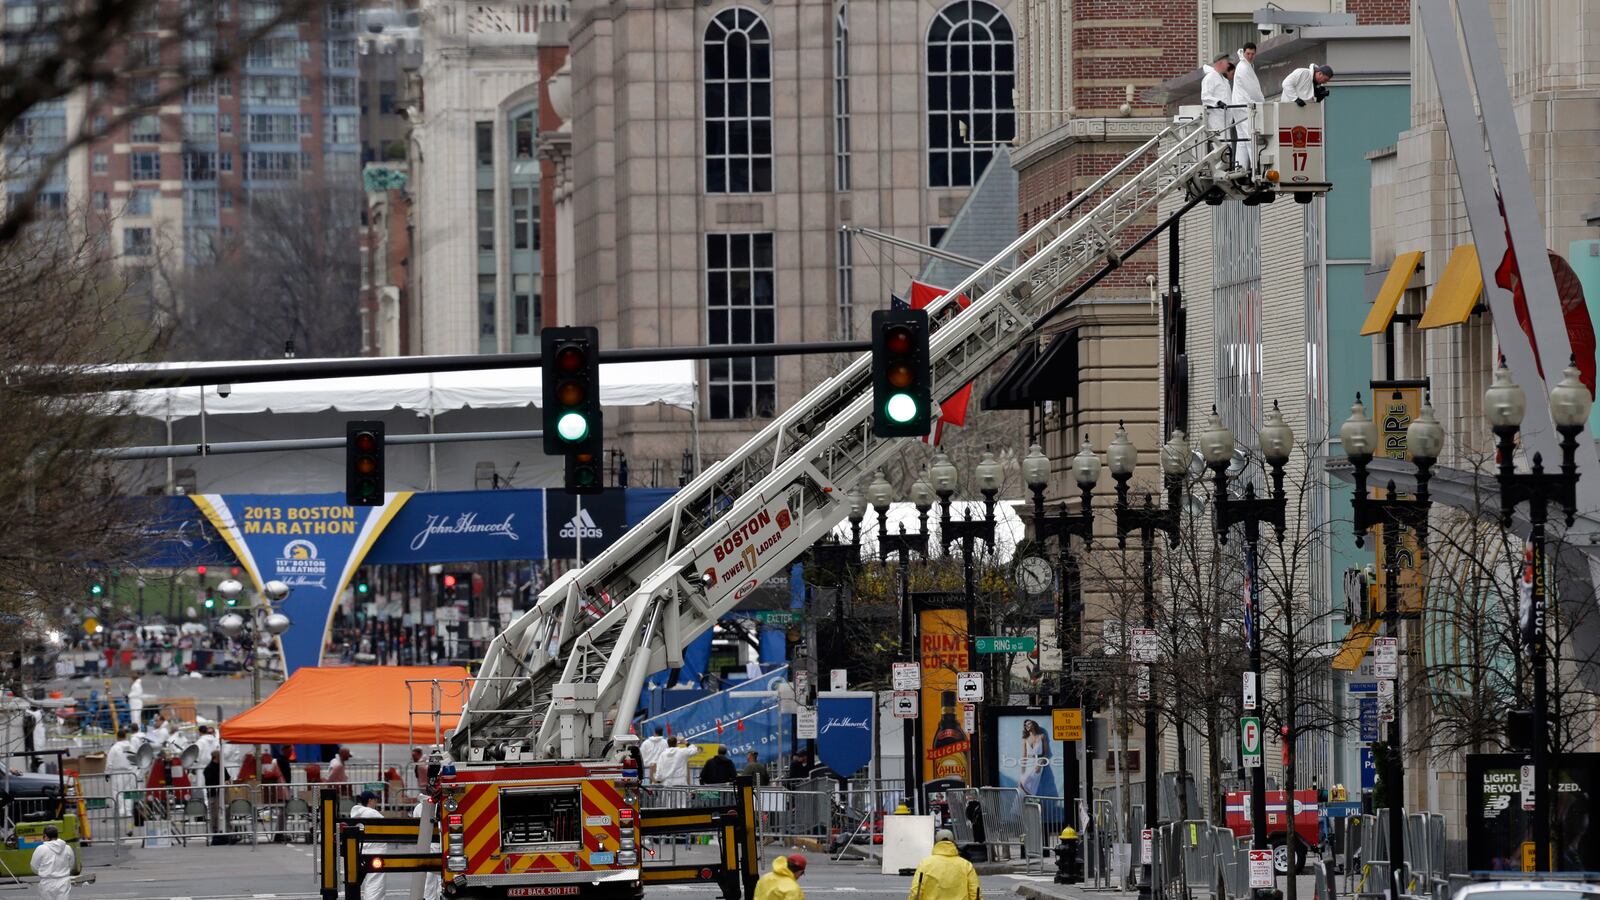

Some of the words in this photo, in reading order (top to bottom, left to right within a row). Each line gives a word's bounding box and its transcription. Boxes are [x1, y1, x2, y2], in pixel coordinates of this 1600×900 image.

[1293, 153, 1307, 171] 17
[1384, 403, 1410, 460] ERRE
[244, 507, 281, 519] 2013
[288, 507, 354, 519] BOSTON
[245, 521, 355, 534] MARATHON
[410, 513, 453, 550] John
[453, 511, 519, 541] Hancock
[559, 527, 603, 538] addas
[713, 508, 771, 563] BOSTON
[721, 560, 745, 583] TOWER
[741, 543, 757, 572] 17
[756, 531, 782, 556] LADDER
[766, 613, 793, 623] EXETER
[993, 640, 1011, 651] RING
[922, 653, 969, 669] COFFE
[1247, 725, 1255, 748] F
[928, 742, 970, 759] DELICIOS
[1001, 753, 1064, 768] bebe
[1483, 774, 1518, 783] LIGHT.
[508, 888, 526, 896] KEEP
[527, 887, 545, 896] BACK
[547, 887, 561, 895] 500
[563, 886, 578, 895] FEET
